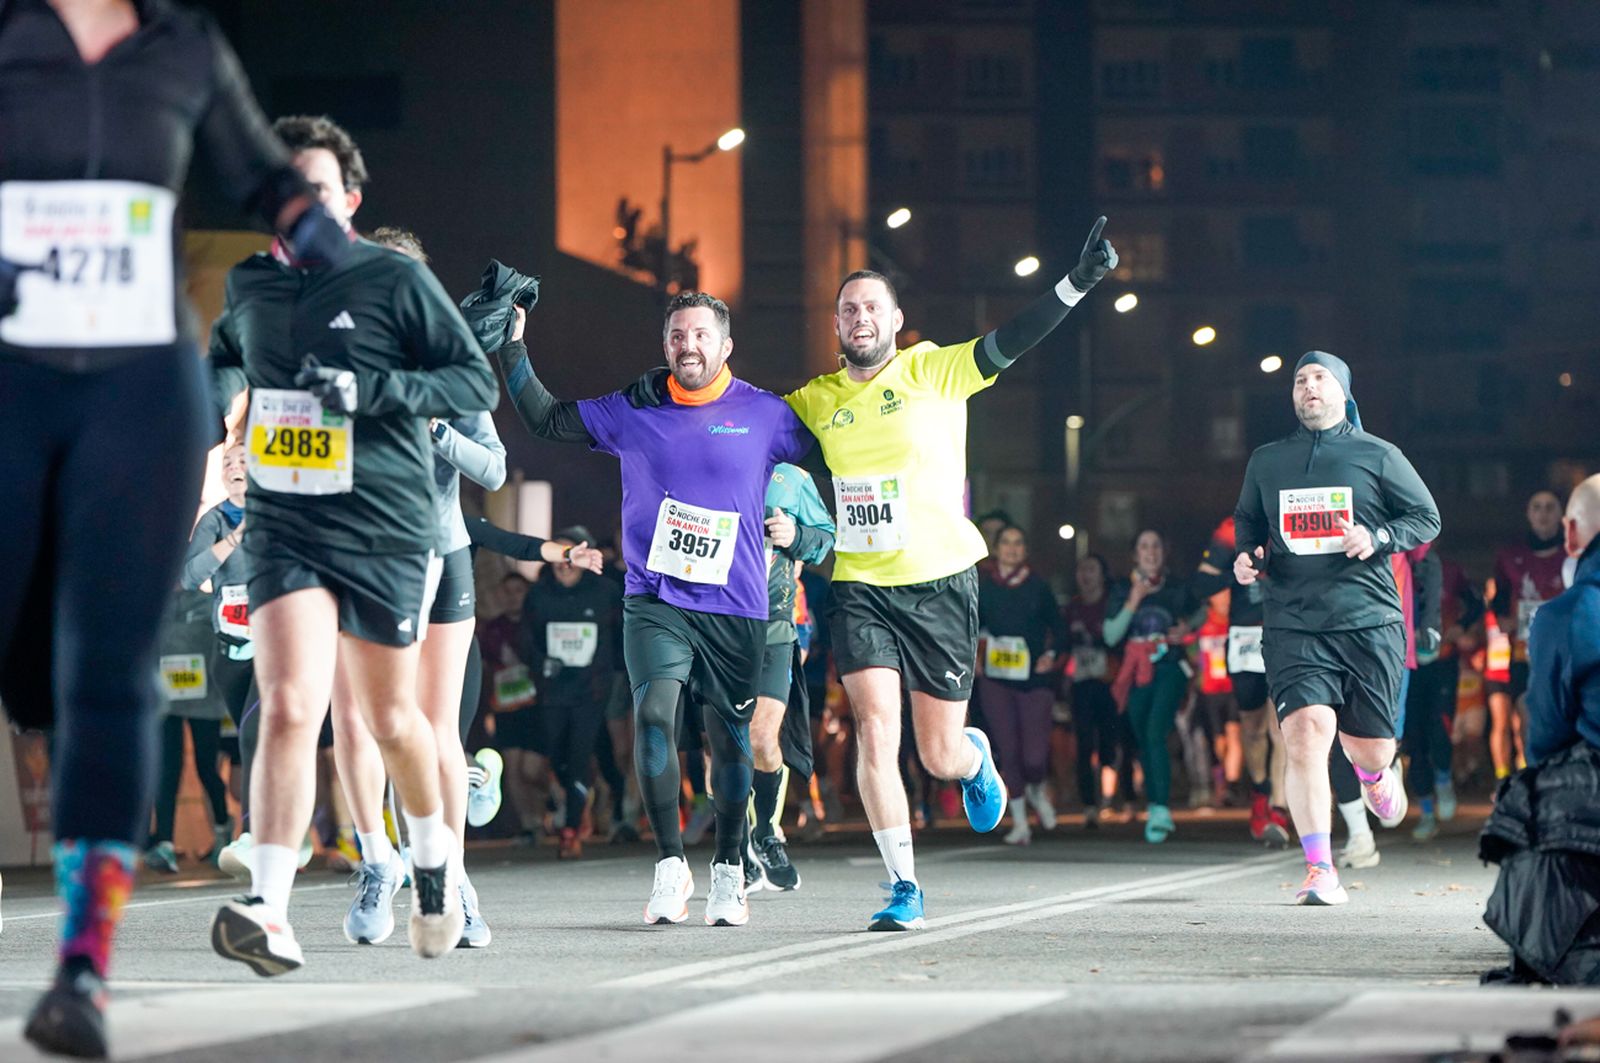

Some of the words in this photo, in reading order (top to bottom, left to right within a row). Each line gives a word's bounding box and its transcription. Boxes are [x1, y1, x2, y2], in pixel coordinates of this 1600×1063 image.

[263, 428, 331, 459] 2983
[841, 494, 852, 503] SAN
[666, 516, 683, 529] SAN
[676, 510, 701, 524] NOCHE
[700, 517, 712, 526] DE
[846, 503, 893, 526] 3904
[668, 528, 722, 560] 3957
